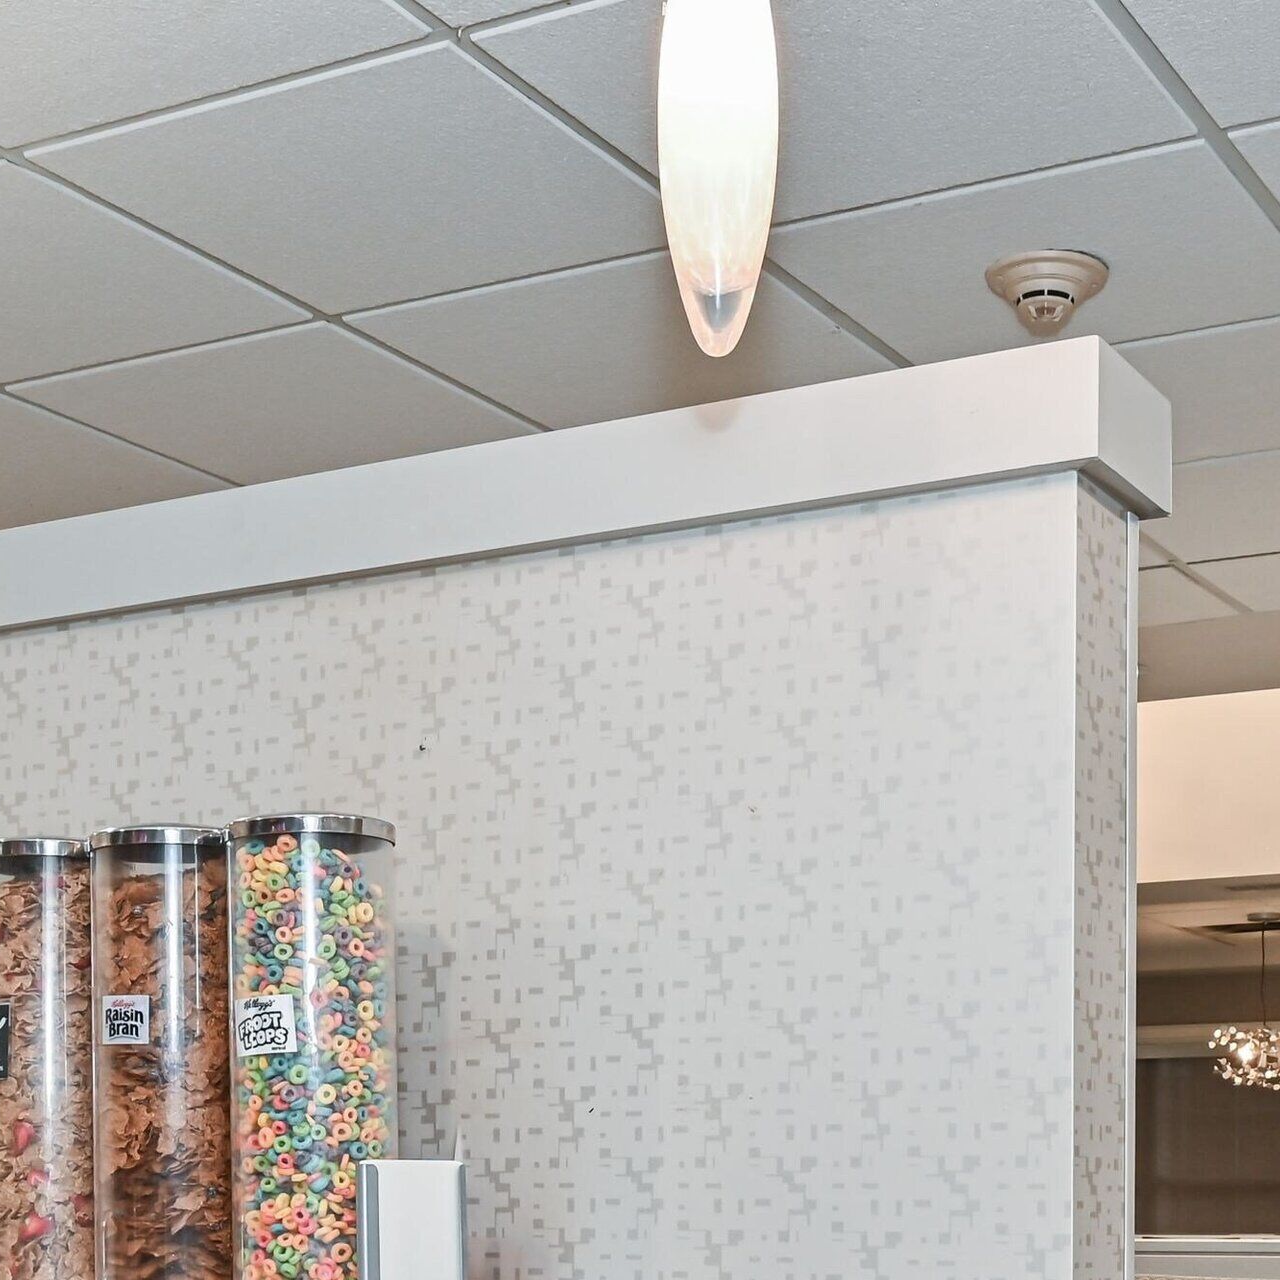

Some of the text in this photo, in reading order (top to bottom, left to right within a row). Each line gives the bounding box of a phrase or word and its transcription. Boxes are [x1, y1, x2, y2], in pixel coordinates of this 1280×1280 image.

[106, 1008, 144, 1025] Raisin
[238, 1011, 282, 1041] FROOT
[109, 1022, 139, 1038] Bran
[244, 1027, 289, 1051] LOOPS
